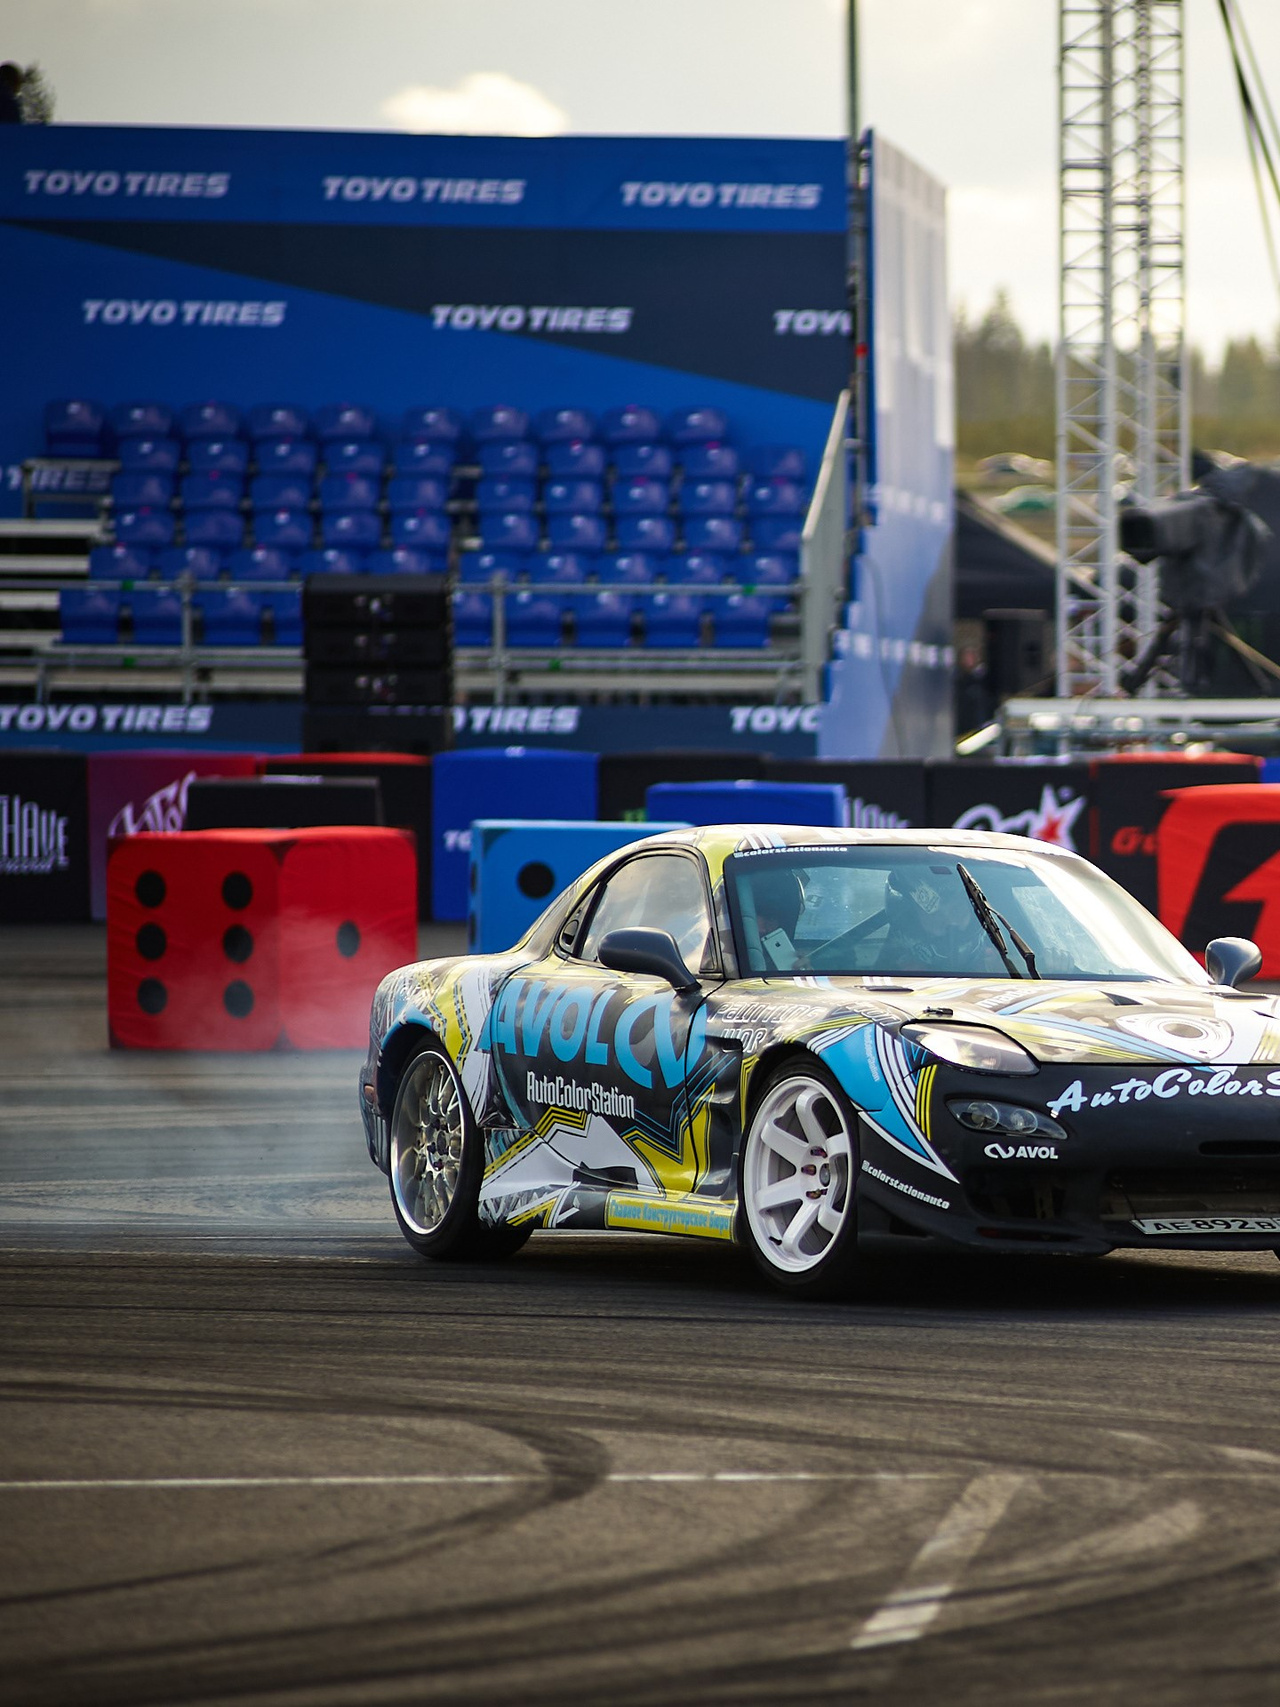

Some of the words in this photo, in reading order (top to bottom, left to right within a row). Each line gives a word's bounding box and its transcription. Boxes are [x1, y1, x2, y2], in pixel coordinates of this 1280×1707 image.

[25, 170, 121, 195] TOYO
[125, 173, 230, 197] TIRES
[323, 176, 417, 201] TOYO
[421, 179, 526, 203] TIRES
[621, 182, 715, 206] TOYO
[718, 184, 822, 208] TIRES
[84, 301, 177, 324] TOYO
[182, 302, 286, 326] TIRES
[432, 305, 525, 330] TOYO
[528, 307, 632, 332] TIRES
[0, 705, 97, 730] TOYO
[101, 706, 213, 731] TIRES
[470, 707, 579, 732] TIRES
[480, 978, 617, 1066] AVOL
[526, 1070, 636, 1119] AutoColorStation
[1015, 1145, 1059, 1160] AVOL
